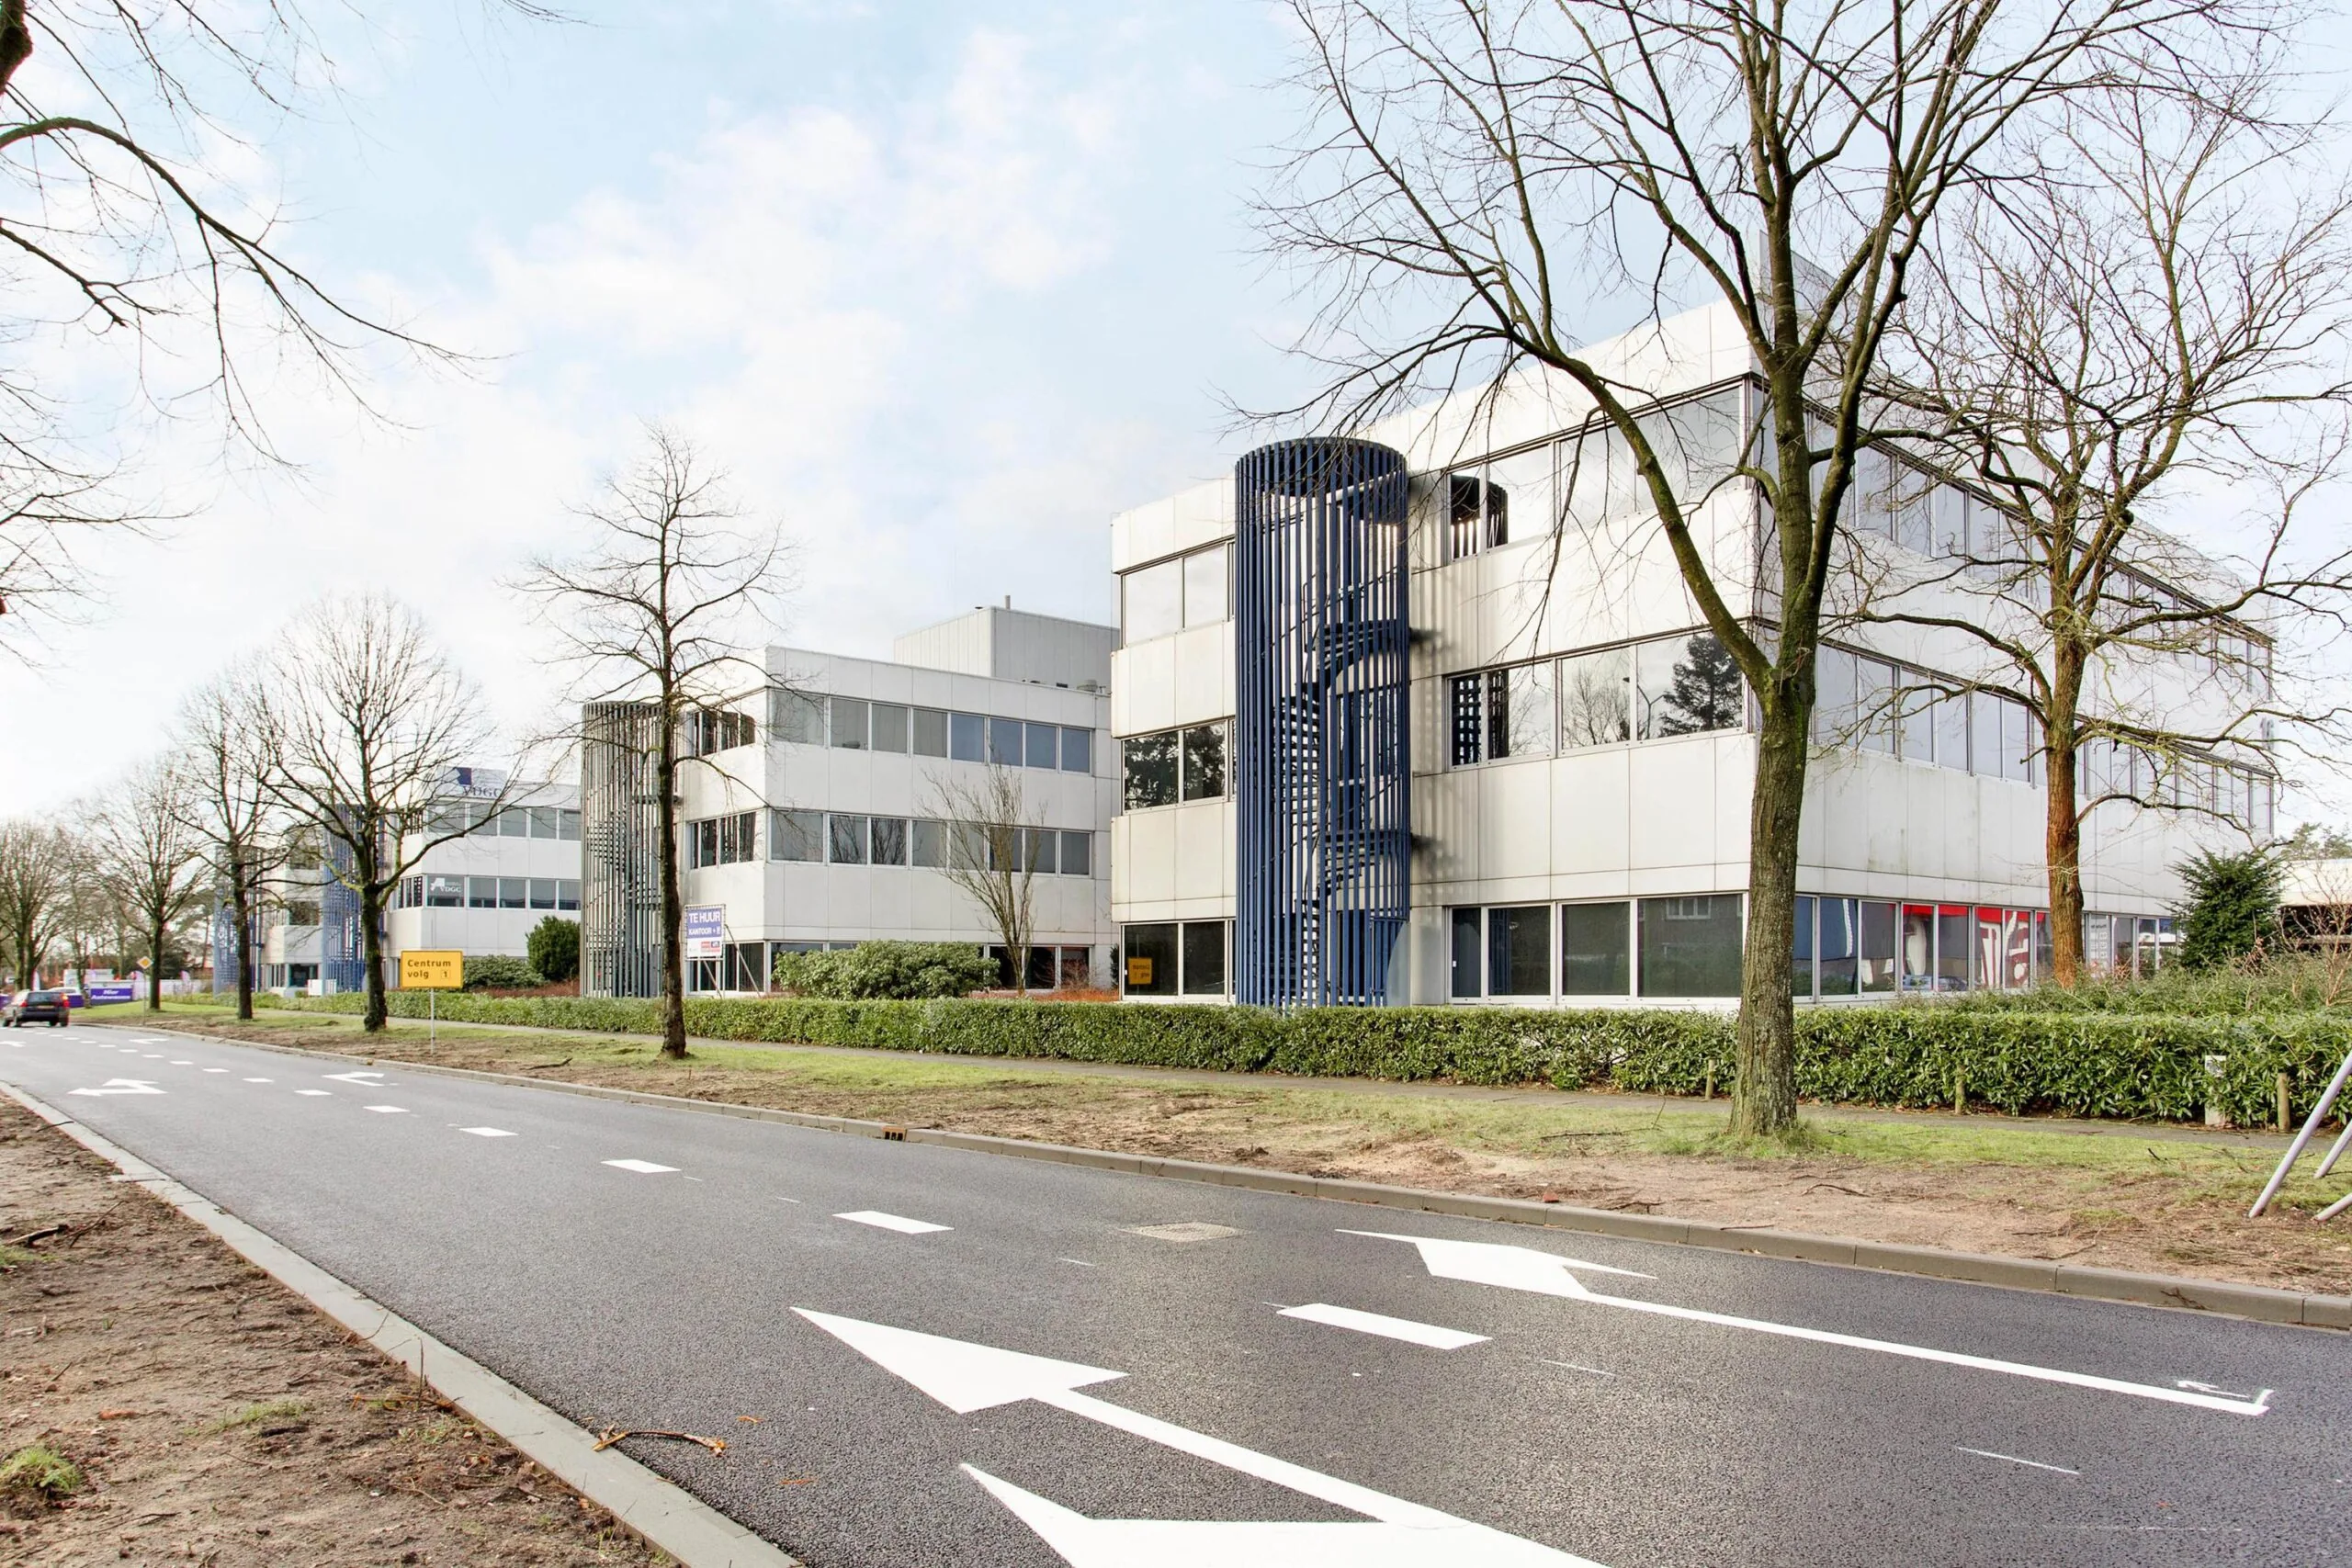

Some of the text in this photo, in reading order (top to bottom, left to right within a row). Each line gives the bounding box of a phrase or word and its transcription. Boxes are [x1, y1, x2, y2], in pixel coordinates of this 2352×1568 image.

[689, 911, 721, 924] TE HUUR
[688, 927, 712, 936] KANTOOR
[407, 959, 451, 967] Centrum
[407, 970, 429, 979] volg
